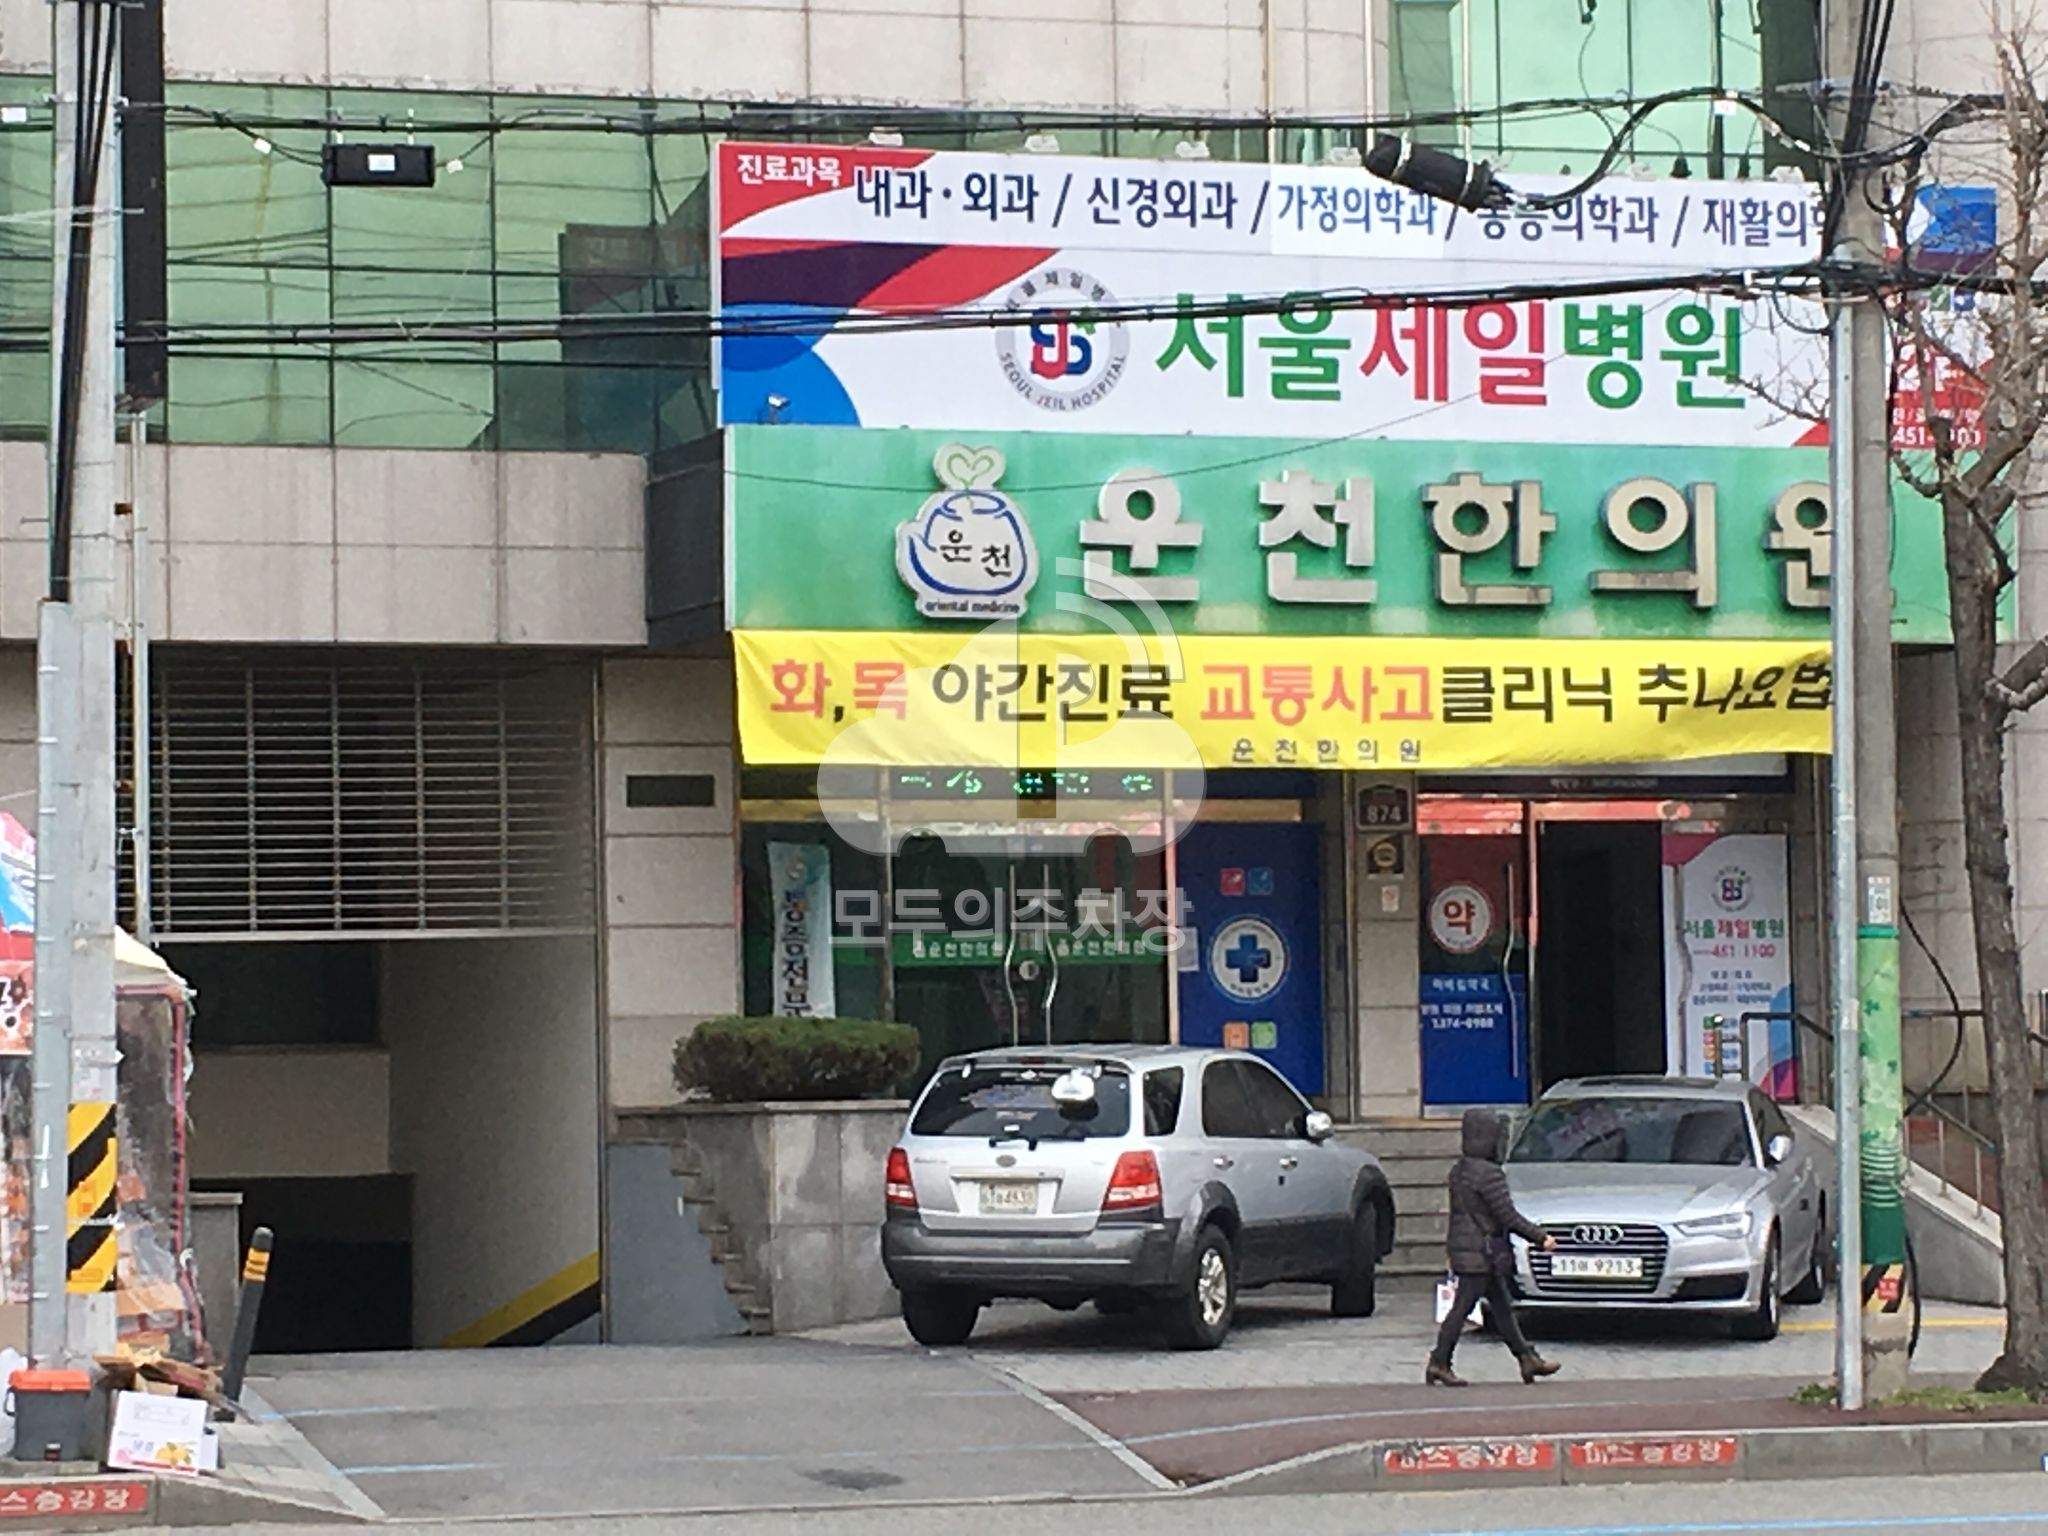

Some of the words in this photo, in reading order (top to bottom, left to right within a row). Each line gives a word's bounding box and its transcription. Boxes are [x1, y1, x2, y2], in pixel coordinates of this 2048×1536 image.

[736, 154, 842, 187] 진료과목
[1087, 176, 1238, 229] 신경외과
[1277, 183, 1438, 235] 가정의학과
[1156, 291, 1746, 410] 서울제일병원
[931, 662, 1174, 722] 야간진료
[1638, 663, 1834, 724] 추나요법
[1367, 804, 1402, 823] 874
[1443, 899, 1477, 936] 약
